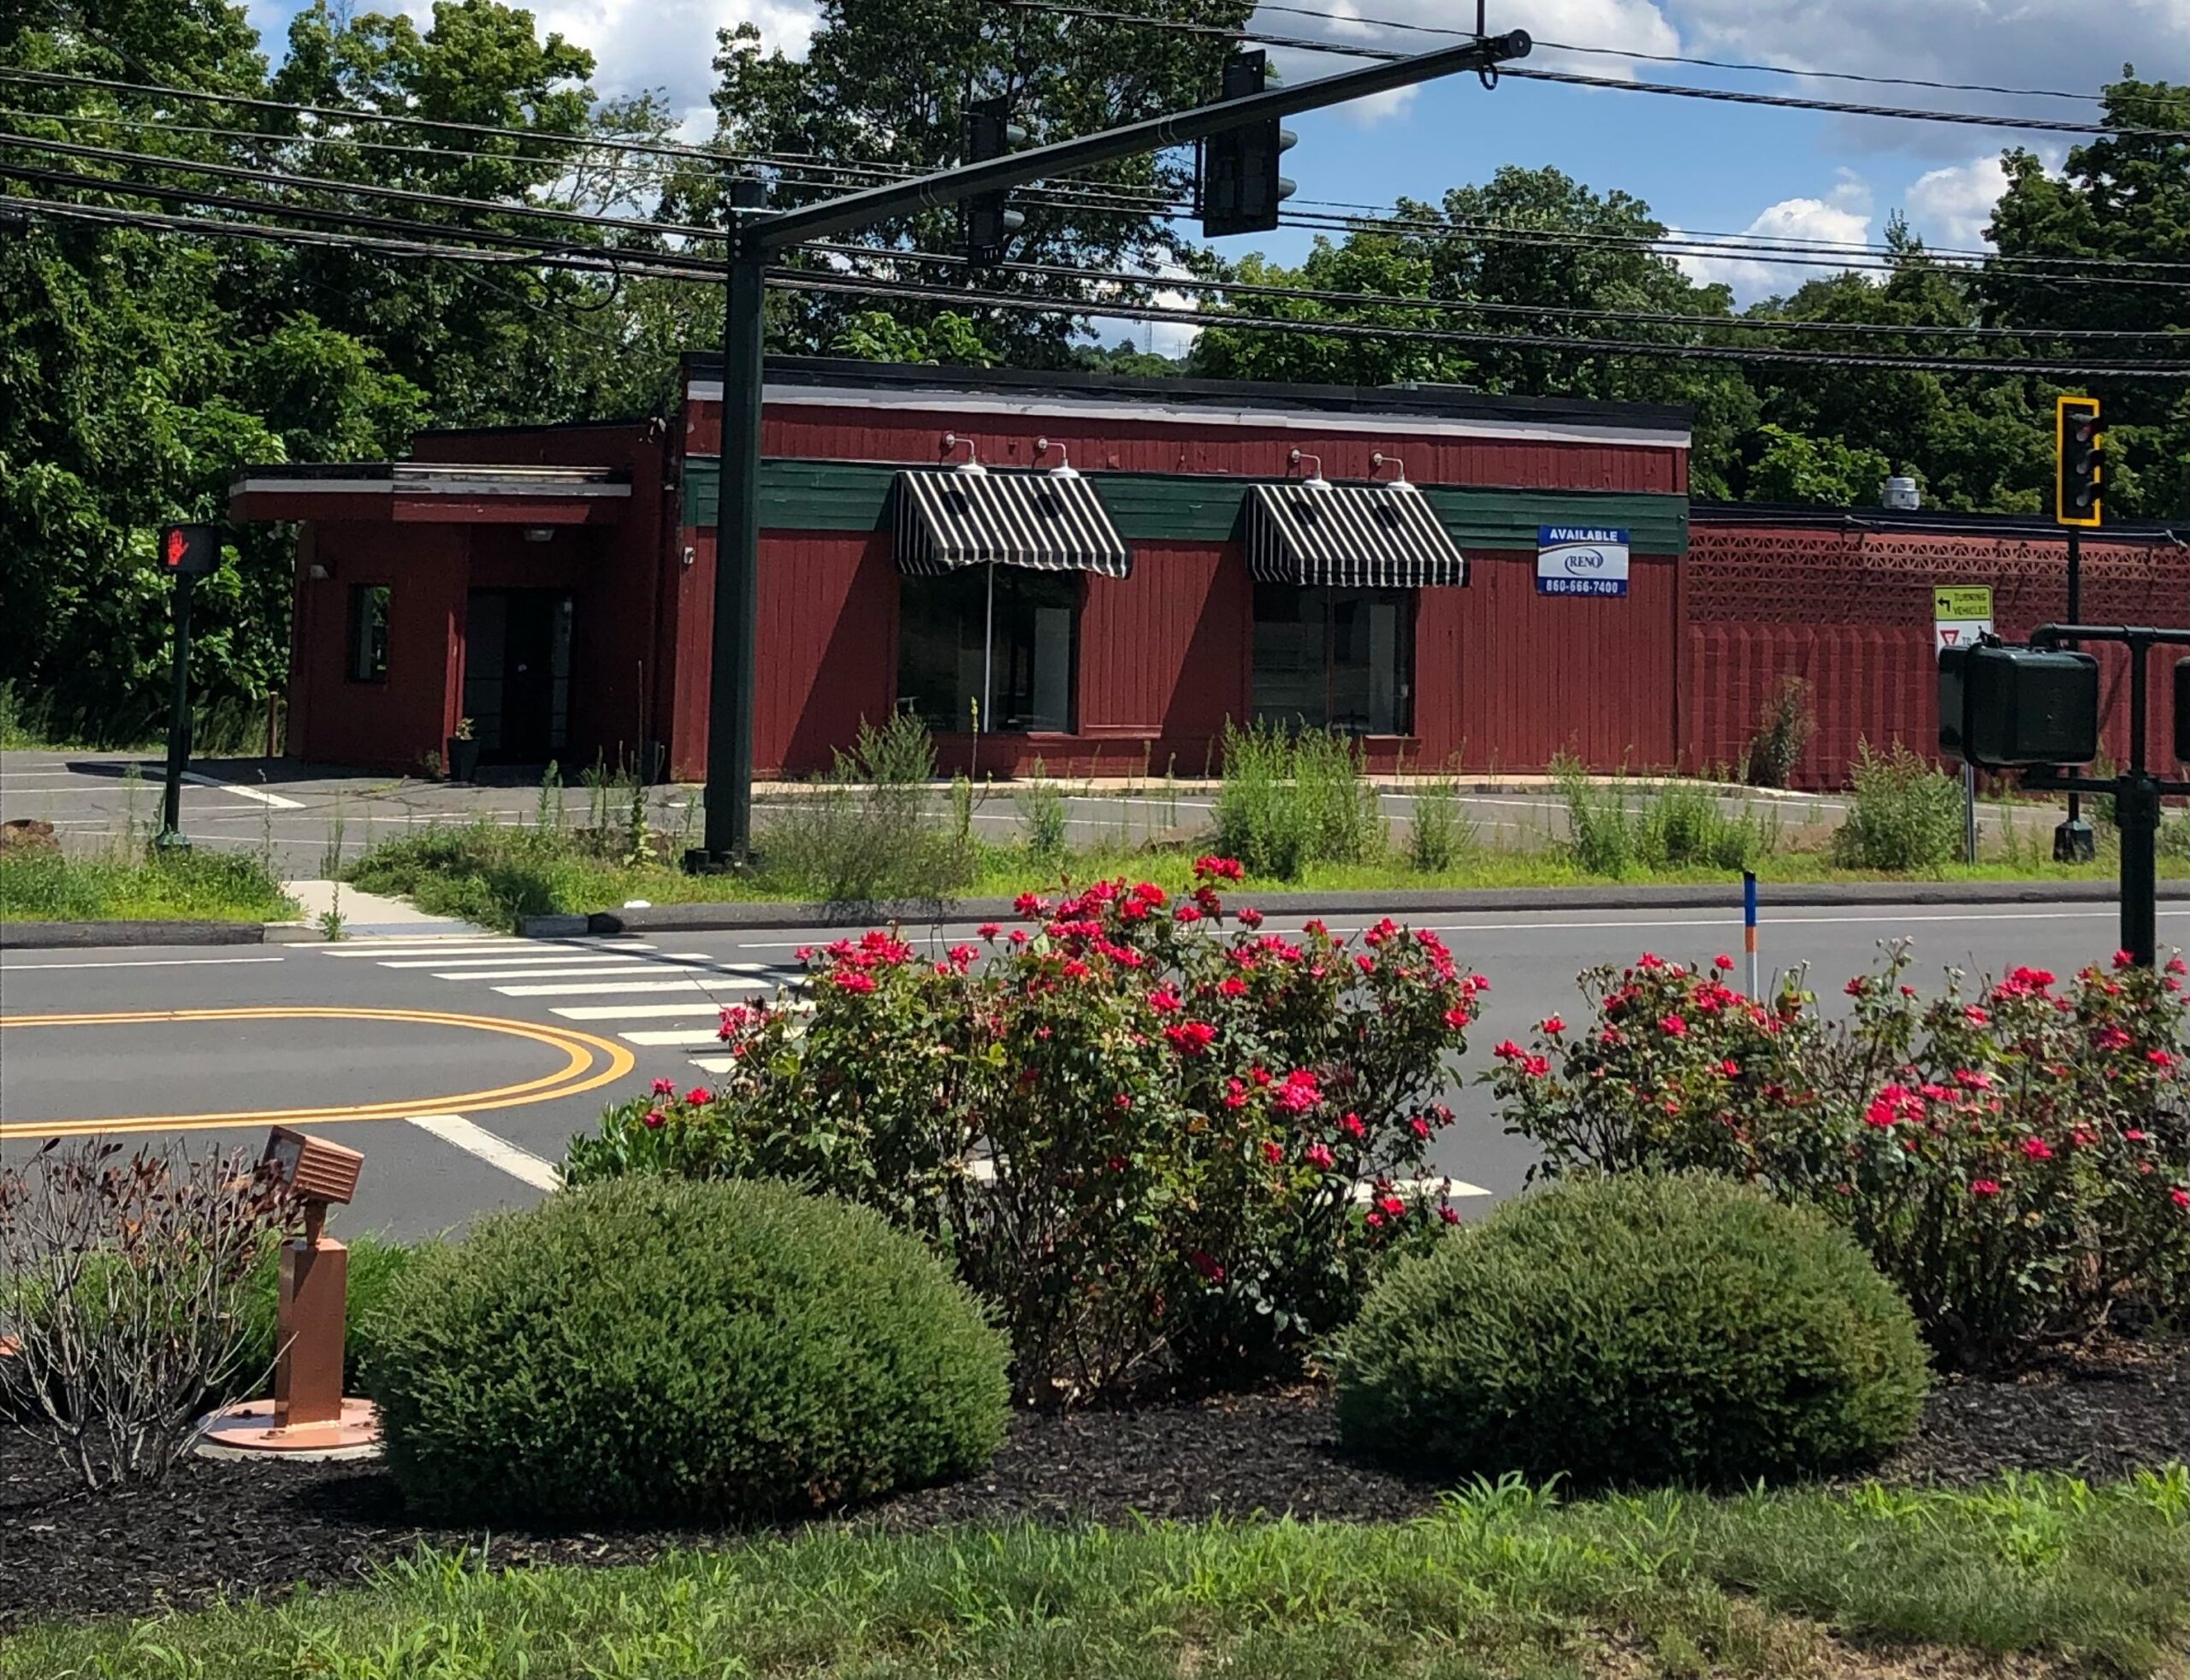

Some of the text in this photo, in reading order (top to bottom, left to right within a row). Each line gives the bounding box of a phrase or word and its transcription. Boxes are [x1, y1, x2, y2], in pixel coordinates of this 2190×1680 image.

[1549, 529, 1618, 541] AVAILABLE
[1569, 555, 1601, 569] RENO
[1546, 580, 1619, 593] 860-666-7400
